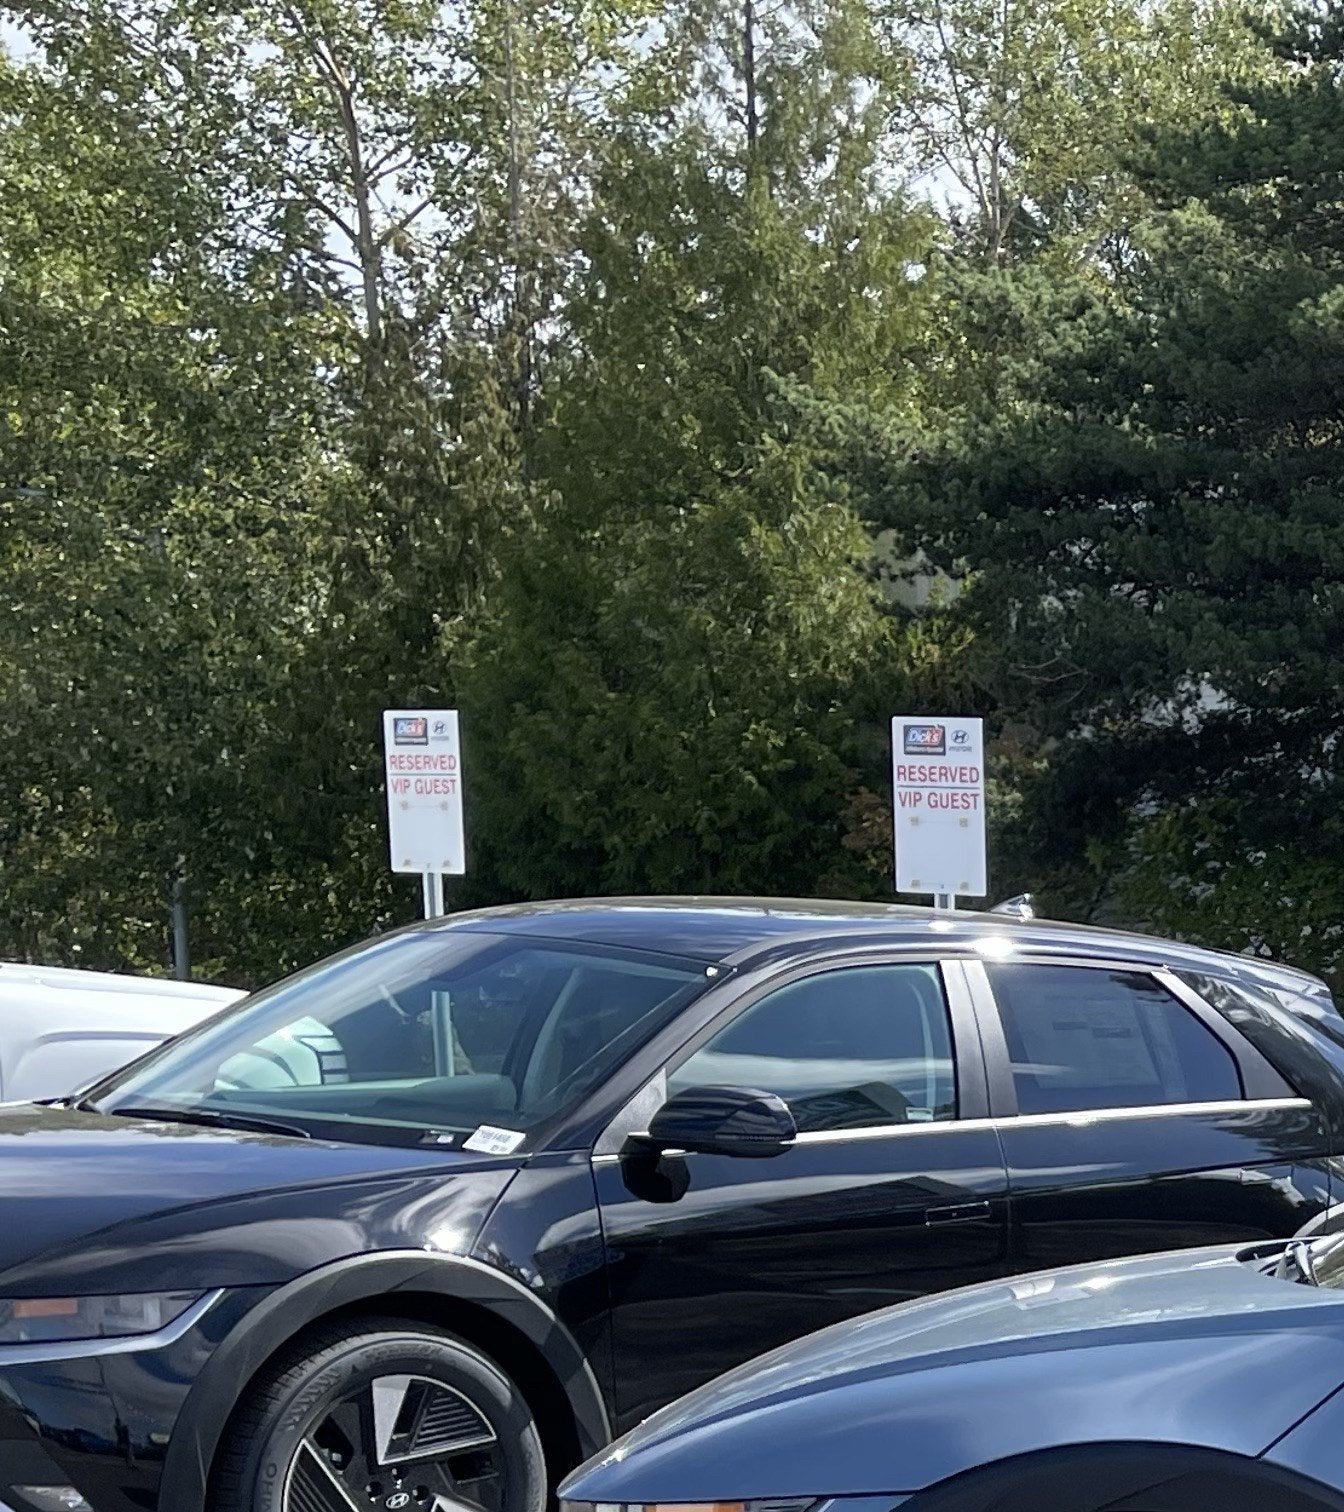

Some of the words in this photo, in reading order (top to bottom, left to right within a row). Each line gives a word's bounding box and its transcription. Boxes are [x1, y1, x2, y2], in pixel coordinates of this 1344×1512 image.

[389, 754, 457, 771] RESERVED
[896, 765, 980, 784] RESERVED
[391, 778, 411, 794] VIP
[415, 778, 457, 795] GUEST
[898, 791, 923, 808] VIP
[927, 792, 980, 810] GUEST
